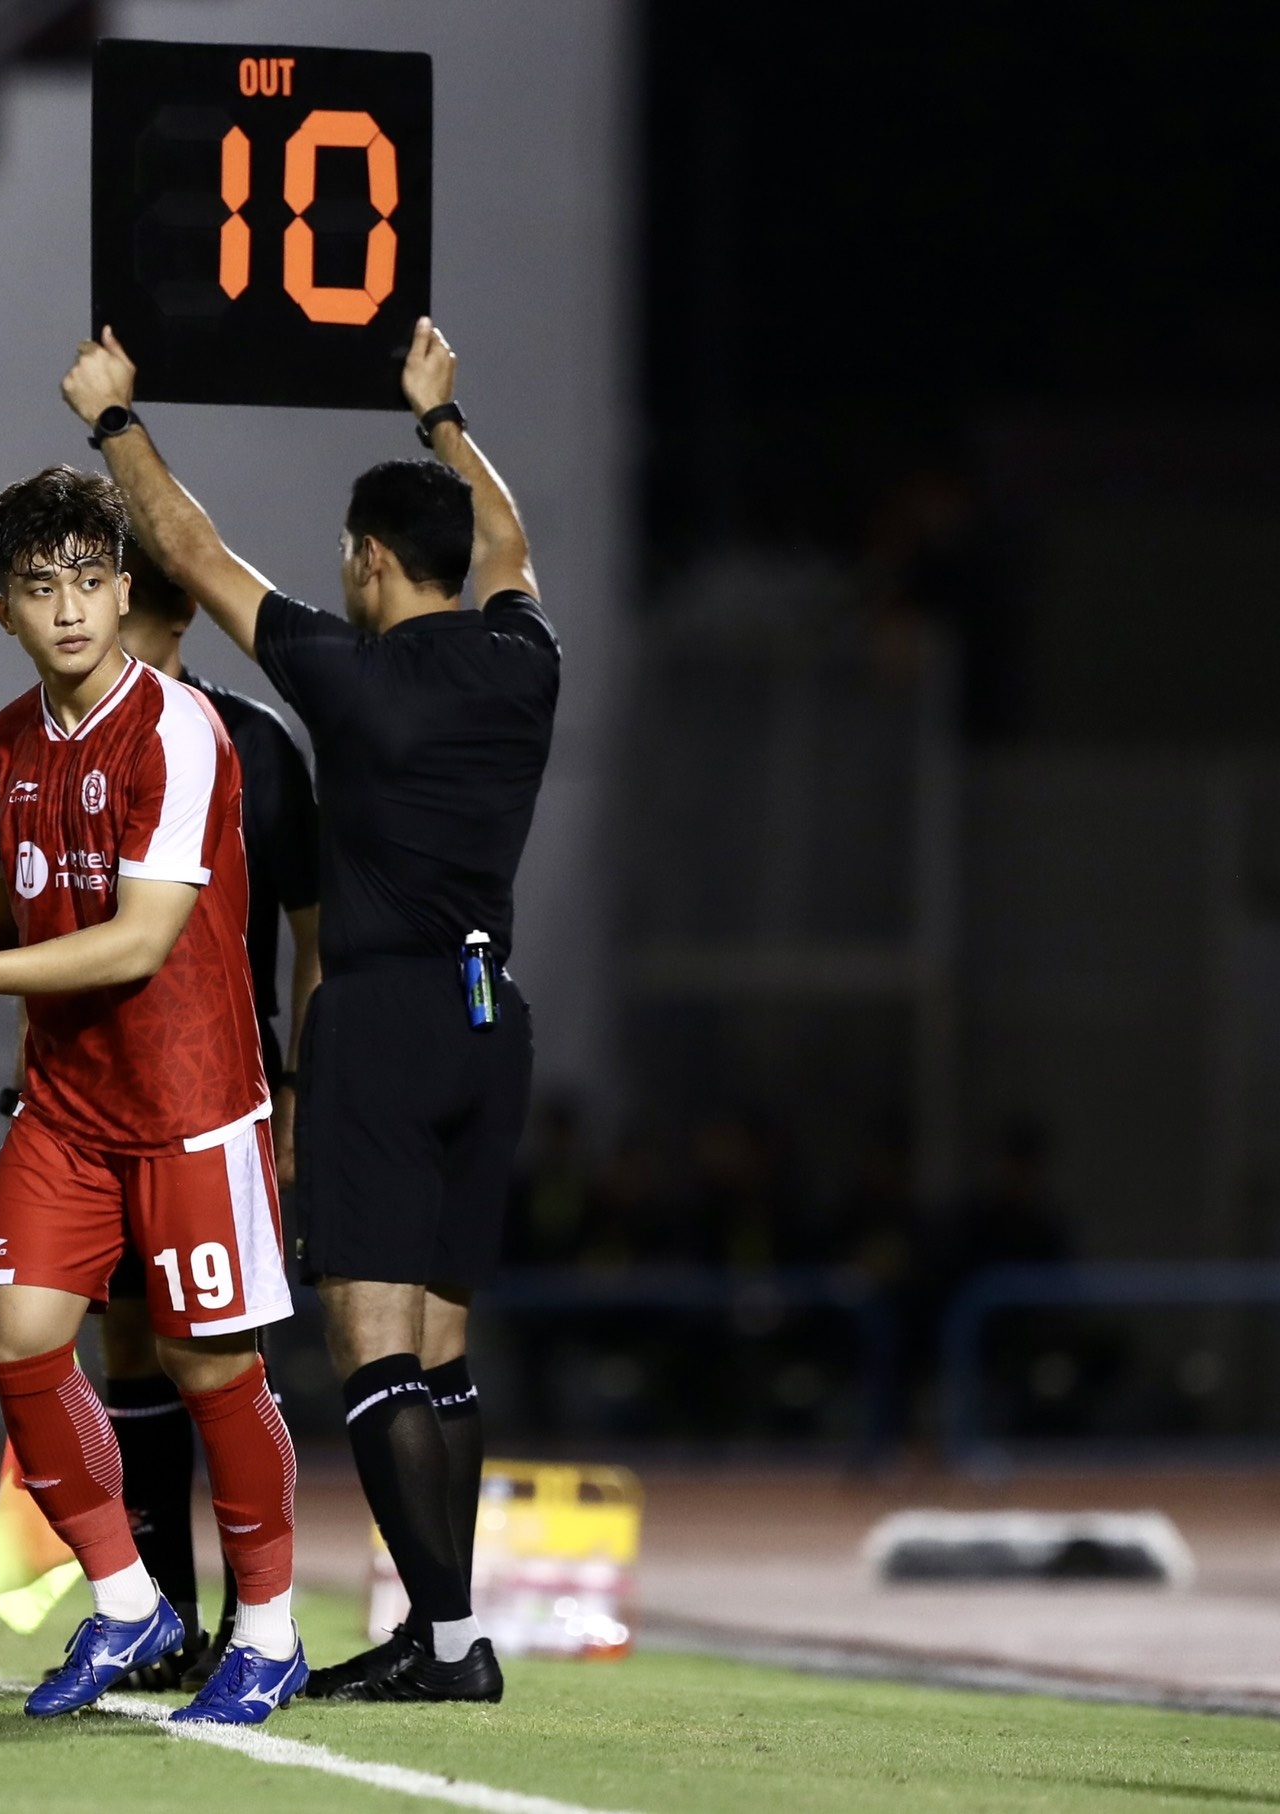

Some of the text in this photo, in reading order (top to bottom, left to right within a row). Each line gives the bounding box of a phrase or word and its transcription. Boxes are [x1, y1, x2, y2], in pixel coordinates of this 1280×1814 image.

[238, 57, 295, 97] OUT
[219, 109, 399, 325] 10
[55, 849, 112, 869] vttel
[153, 1241, 235, 1312] 19
[390, 1381, 430, 1396] KEL
